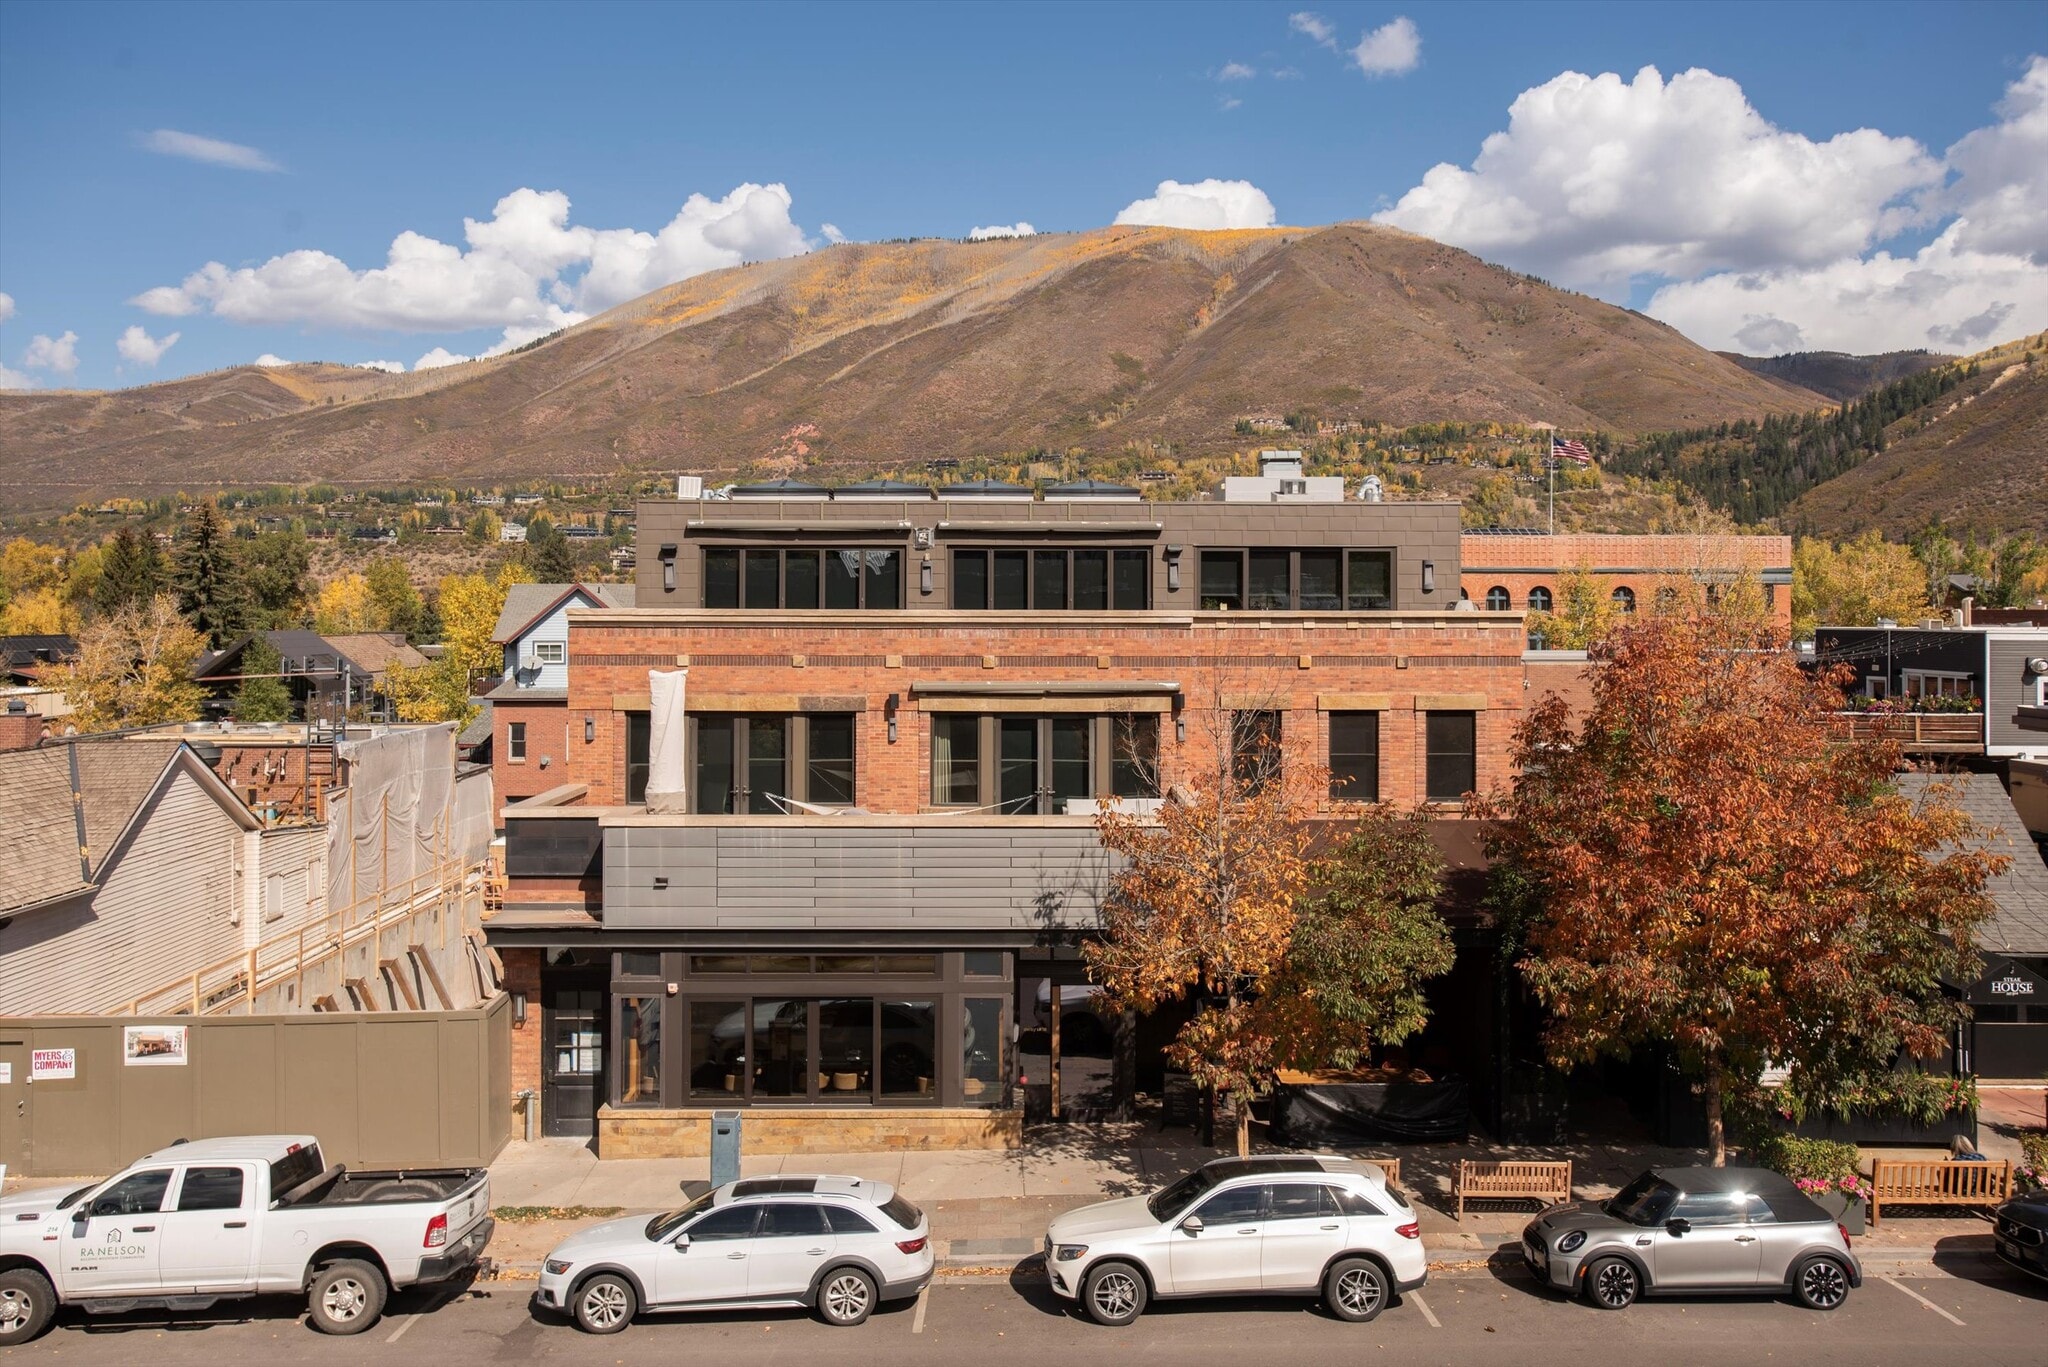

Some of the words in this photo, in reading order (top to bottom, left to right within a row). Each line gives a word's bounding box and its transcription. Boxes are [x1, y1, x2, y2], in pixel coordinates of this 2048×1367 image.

[1991, 982, 2034, 992] HOUSE
[34, 1050, 62, 1061] MYERS
[34, 1060, 73, 1070] COMPANY
[80, 1247, 95, 1257] RA
[97, 1245, 146, 1256] NELSON
